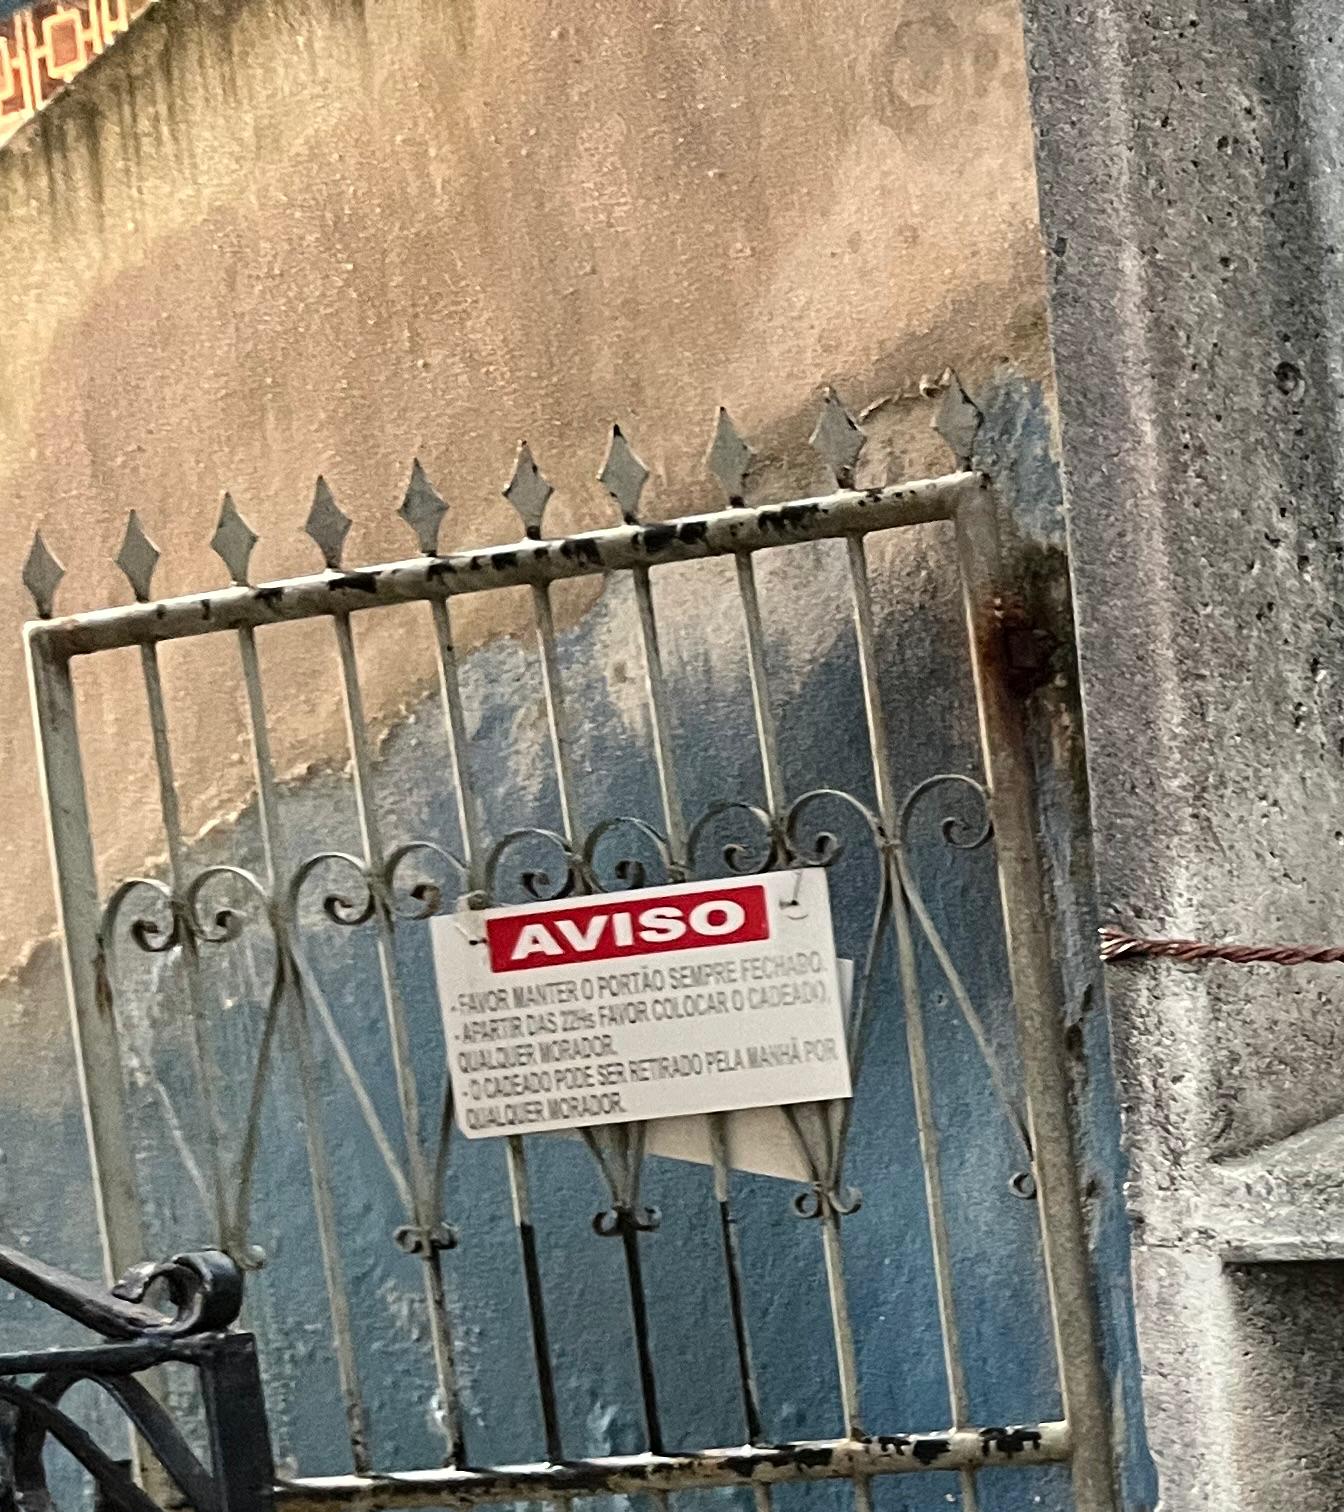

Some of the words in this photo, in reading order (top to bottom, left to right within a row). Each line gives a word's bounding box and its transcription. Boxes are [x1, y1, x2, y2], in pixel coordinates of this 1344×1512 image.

[511, 900, 746, 960] AVISO
[579, 979, 593, 999] O
[669, 962, 736, 989] SEMPRE
[730, 991, 744, 1011] O
[705, 1050, 743, 1073] PELA
